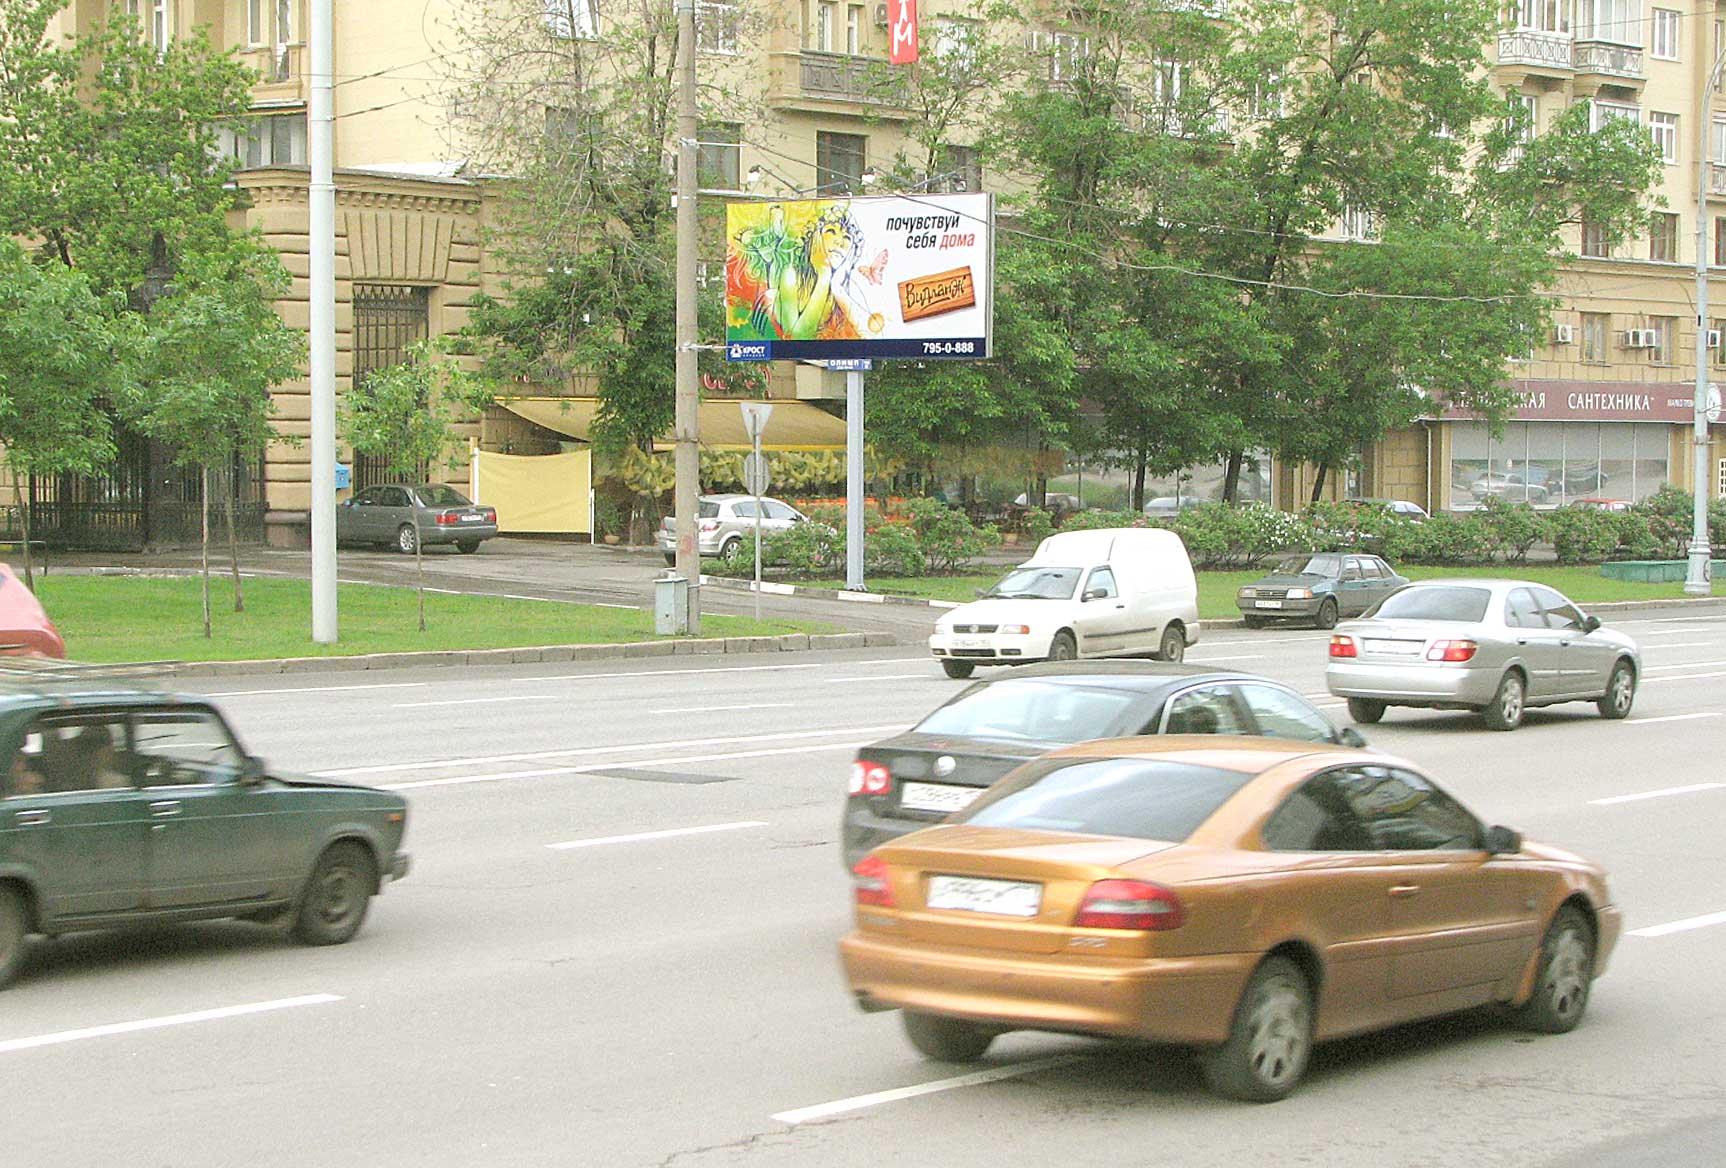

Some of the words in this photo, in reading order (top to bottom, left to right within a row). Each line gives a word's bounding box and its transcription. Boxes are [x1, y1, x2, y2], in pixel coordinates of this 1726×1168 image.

[906, 231, 937, 249] себя
[939, 233, 975, 250] дома
[922, 342, 974, 354] 795-0-888
[1568, 393, 1650, 410] САНТЕХНИКА
